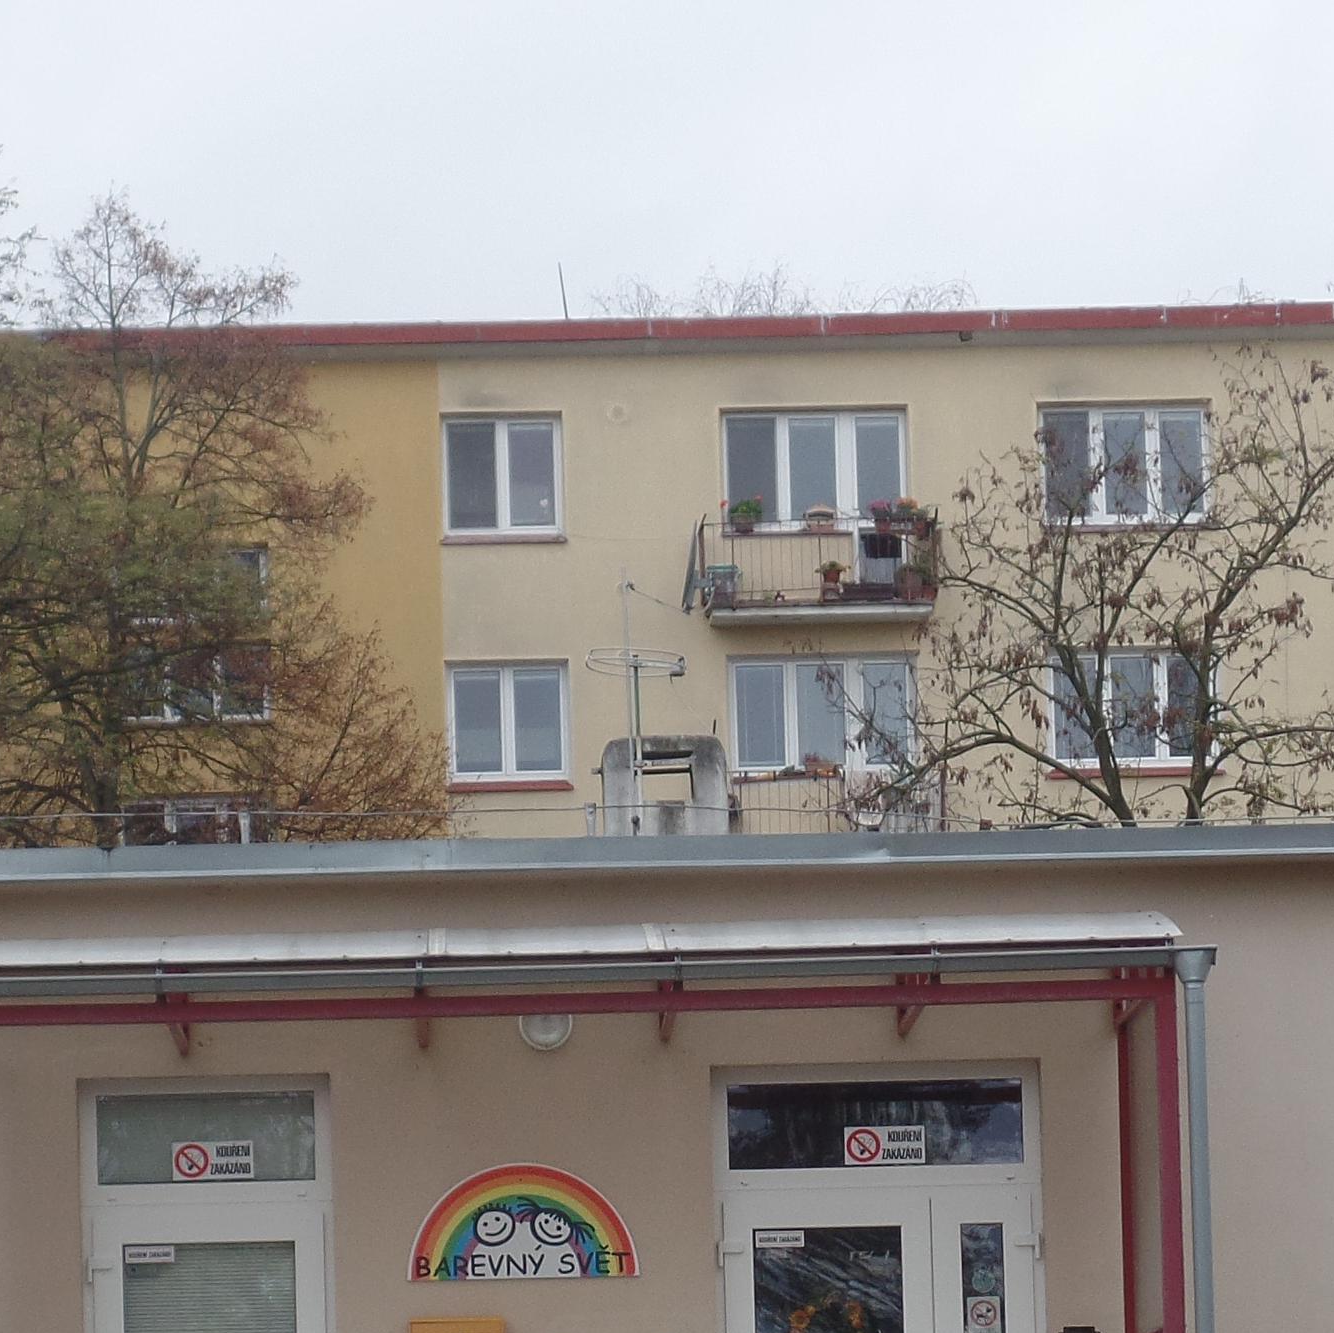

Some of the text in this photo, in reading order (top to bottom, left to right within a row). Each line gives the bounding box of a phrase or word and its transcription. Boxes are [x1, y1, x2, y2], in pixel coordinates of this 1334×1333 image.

[887, 1127, 922, 1142] KOUŘENÍ
[215, 1143, 250, 1158] KOUŘENÍ
[415, 1244, 631, 1278] BAREVNÝ SVĚT
